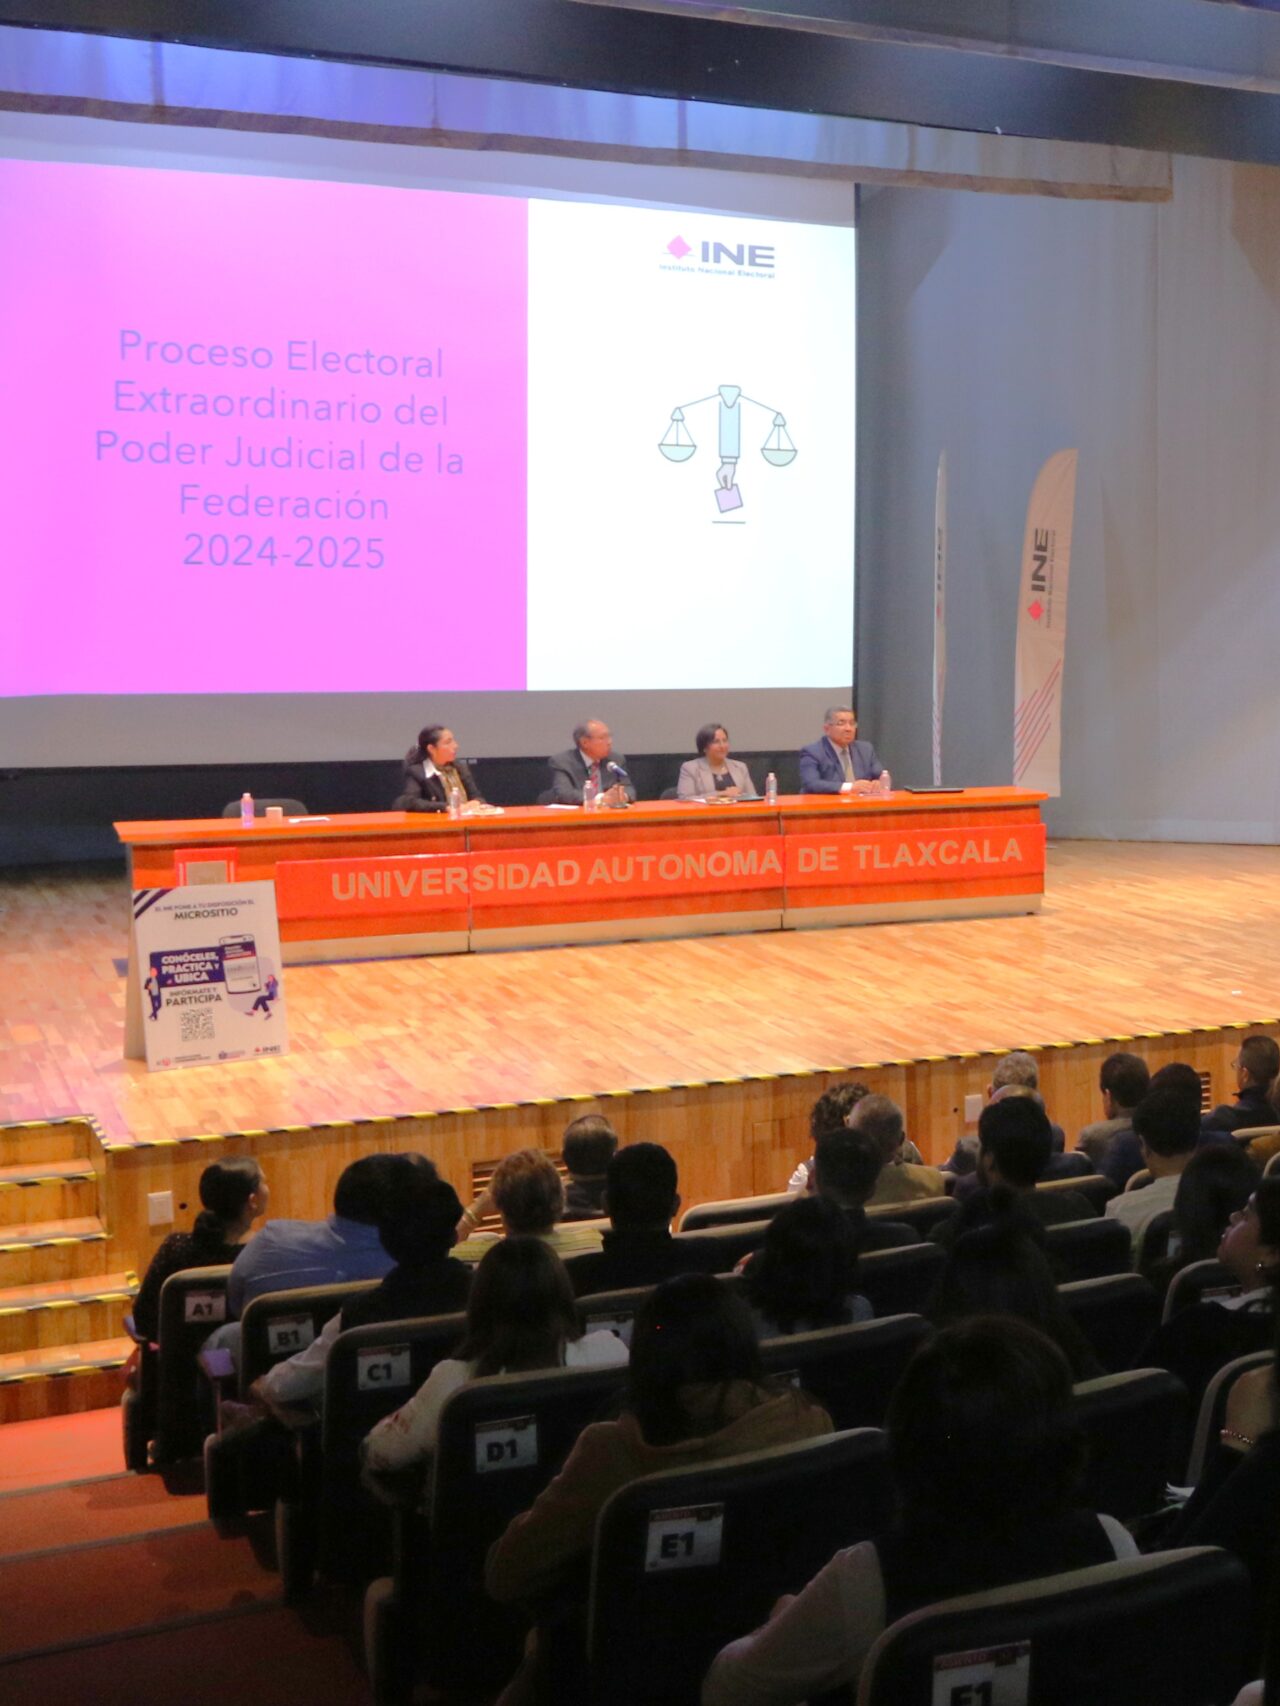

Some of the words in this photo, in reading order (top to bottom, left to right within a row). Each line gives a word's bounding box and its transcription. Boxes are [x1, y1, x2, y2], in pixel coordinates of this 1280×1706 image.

[701, 240, 775, 268] INE
[659, 264, 695, 273] Instituto
[698, 267, 735, 276] Nacional
[737, 270, 776, 279] Electoral
[118, 329, 274, 370] Proceso
[286, 339, 444, 379] Electoral
[113, 379, 382, 424] Extraordinario
[393, 394, 448, 426] del
[95, 430, 213, 465] Poder
[224, 435, 365, 471] Judicial
[379, 441, 424, 474] de
[436, 442, 464, 475] la
[179, 483, 389, 520] Federación
[182, 533, 386, 570] 2024-2025
[1031, 528, 1049, 592] INE
[331, 859, 580, 900] UNIVERSIDAD
[587, 849, 782, 886] AUTONOMA
[799, 846, 839, 873] DE
[852, 838, 1023, 870] TLAXCALA
[174, 907, 239, 920] MICROSITIO
[161, 952, 219, 965] CONÓCELES,
[161, 961, 213, 975] PRACTICA
[174, 971, 210, 984] UBICA
[166, 993, 223, 1007] PARTICIPA
[192, 1303, 213, 1316] A1
[277, 1330, 301, 1346] B1
[367, 1362, 393, 1381] C1
[486, 1439, 518, 1463] D1
[659, 1531, 695, 1559] E1
